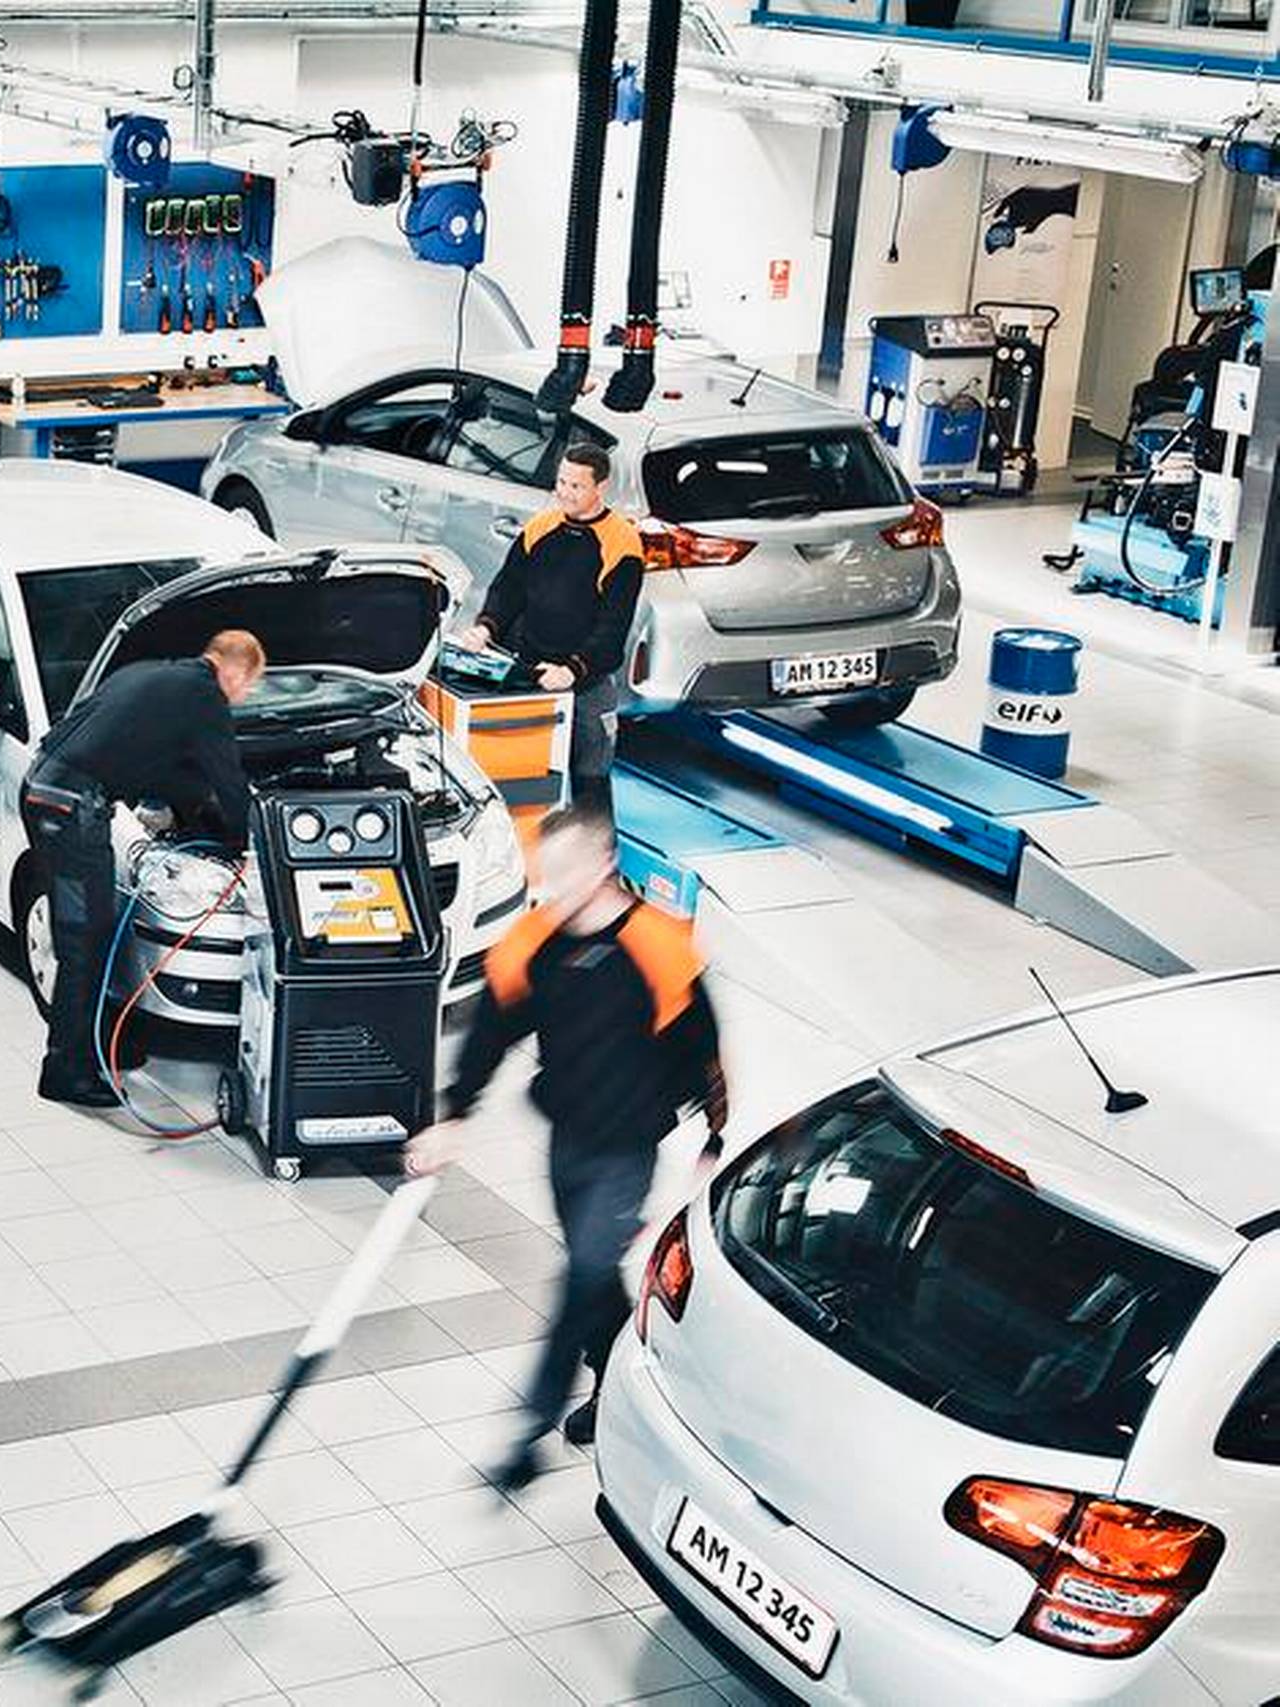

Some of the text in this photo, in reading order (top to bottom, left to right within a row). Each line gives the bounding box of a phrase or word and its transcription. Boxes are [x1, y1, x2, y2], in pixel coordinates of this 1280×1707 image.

[788, 656, 873, 682] AM 12 345
[998, 702, 1042, 721] elf
[689, 1525, 815, 1644] AM 12 345
